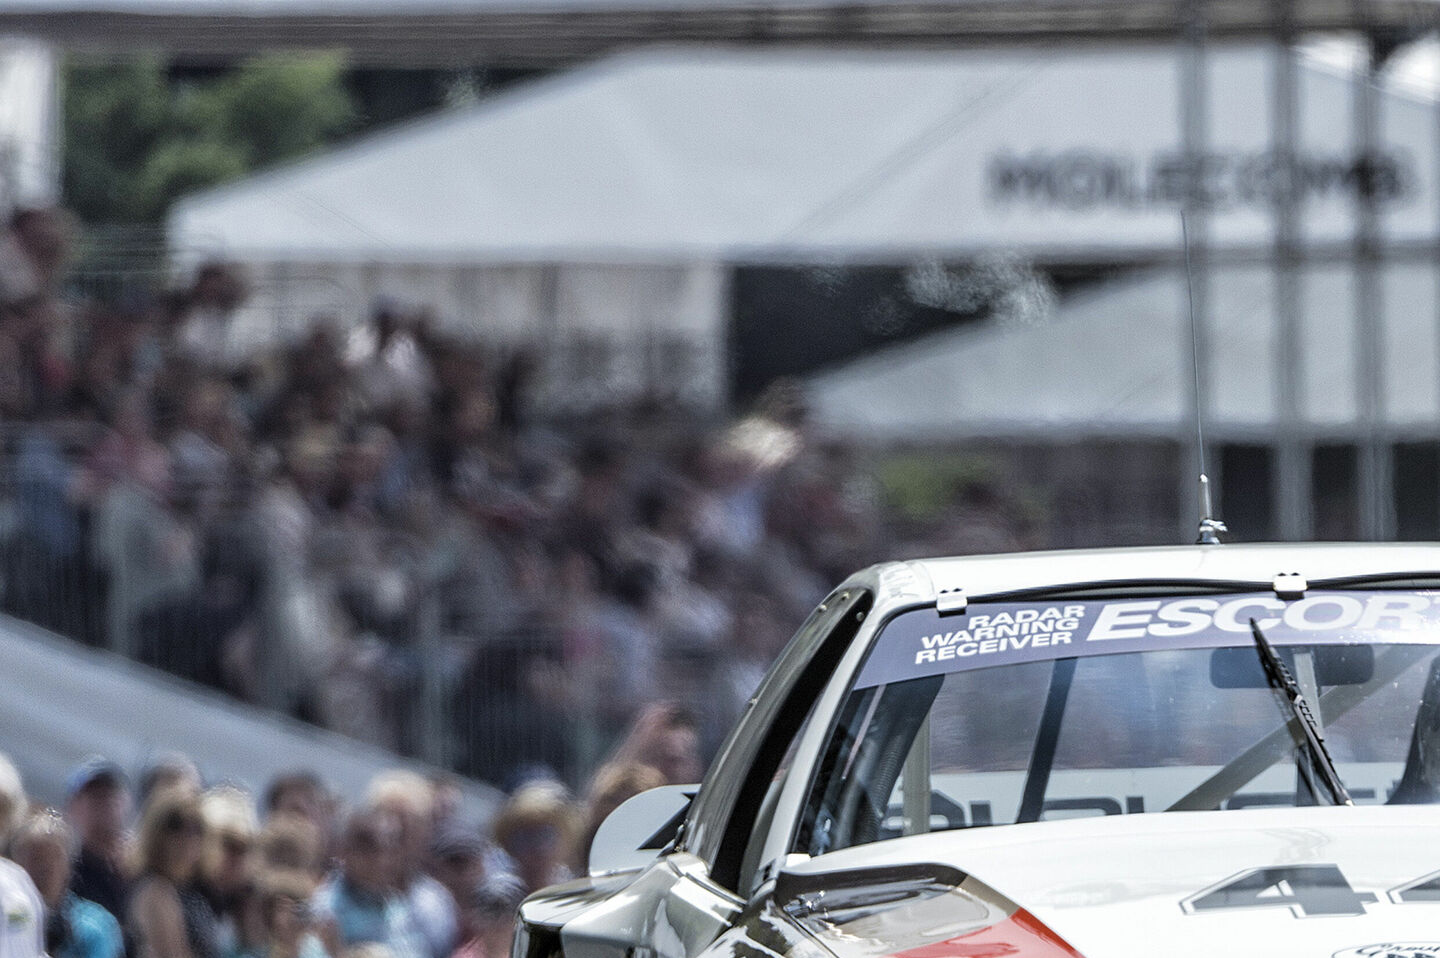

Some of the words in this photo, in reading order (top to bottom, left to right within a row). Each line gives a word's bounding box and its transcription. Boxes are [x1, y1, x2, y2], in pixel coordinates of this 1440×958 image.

[920, 617, 1080, 650] WARNING
[967, 604, 1086, 631] RADAR
[914, 631, 1074, 665] RECEIVER
